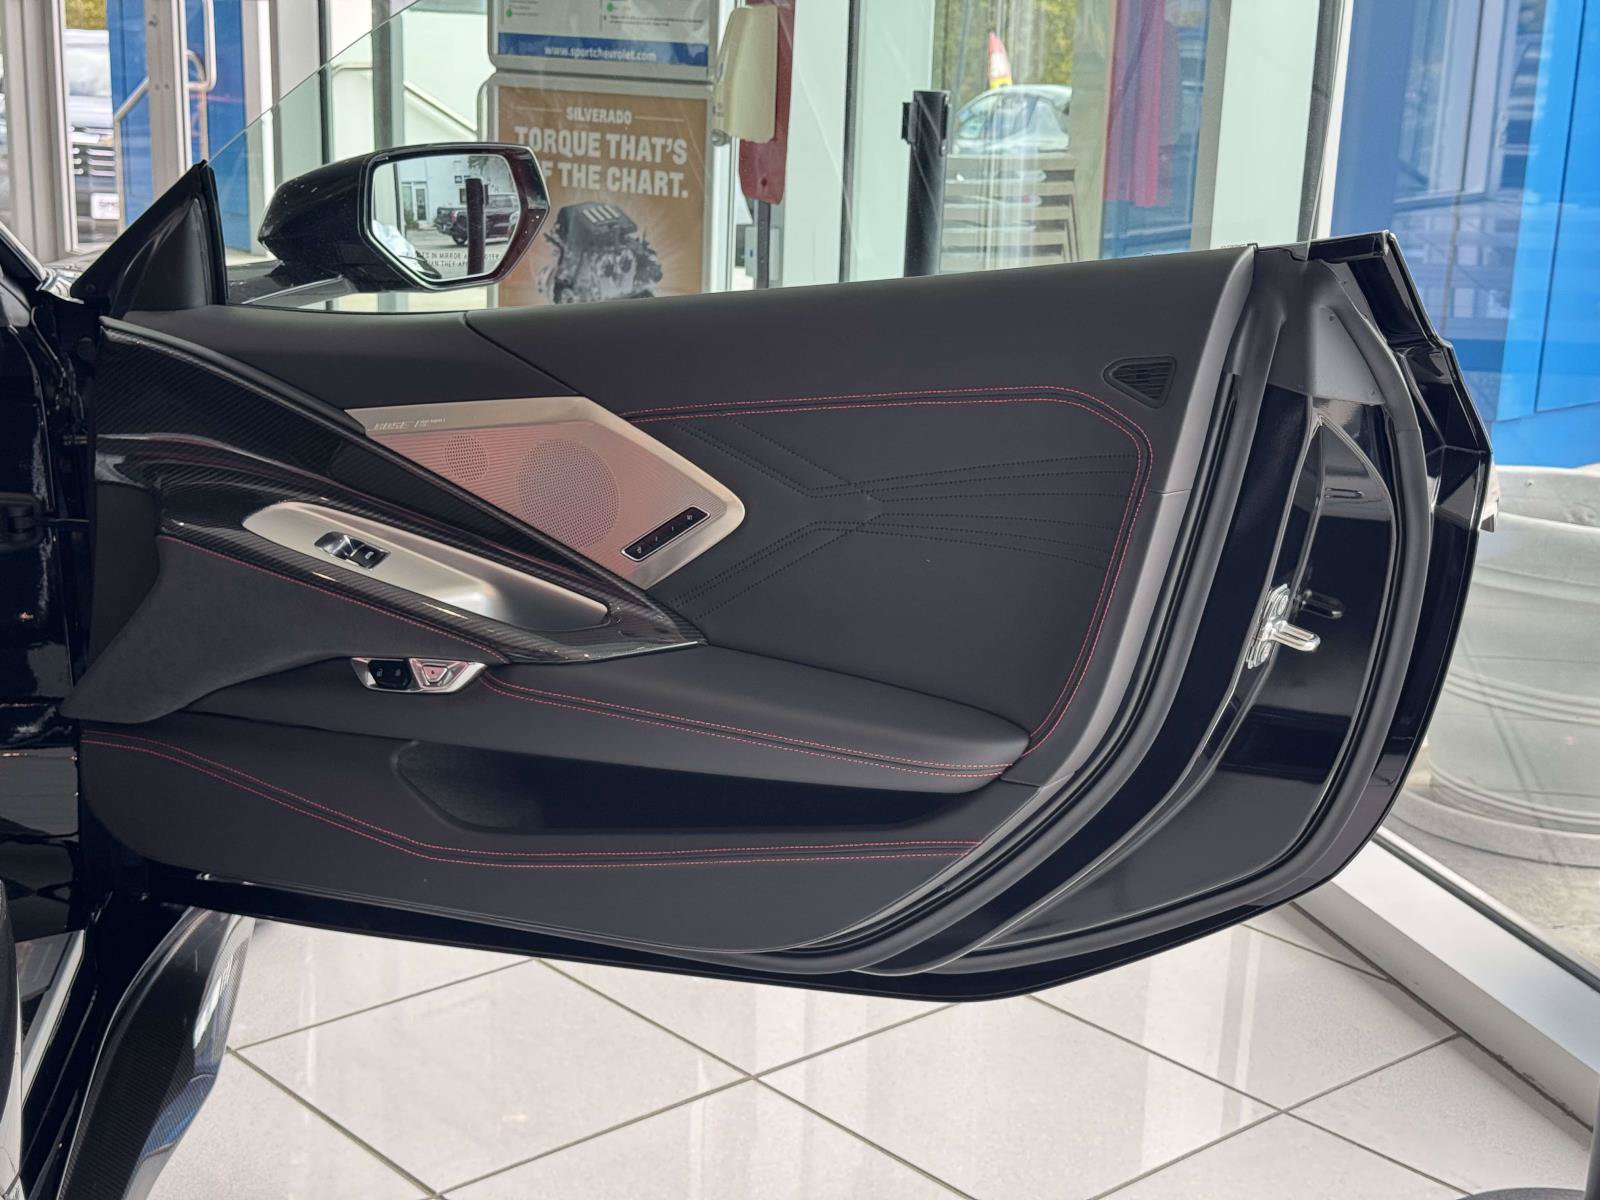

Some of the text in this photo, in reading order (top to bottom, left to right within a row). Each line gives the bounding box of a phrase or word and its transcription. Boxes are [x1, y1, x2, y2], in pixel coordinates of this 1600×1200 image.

[566, 106, 632, 125] SILVERADO
[514, 126, 688, 165] TORQUE THAT'S
[558, 160, 600, 190] THE
[606, 166, 689, 198] CHART.
